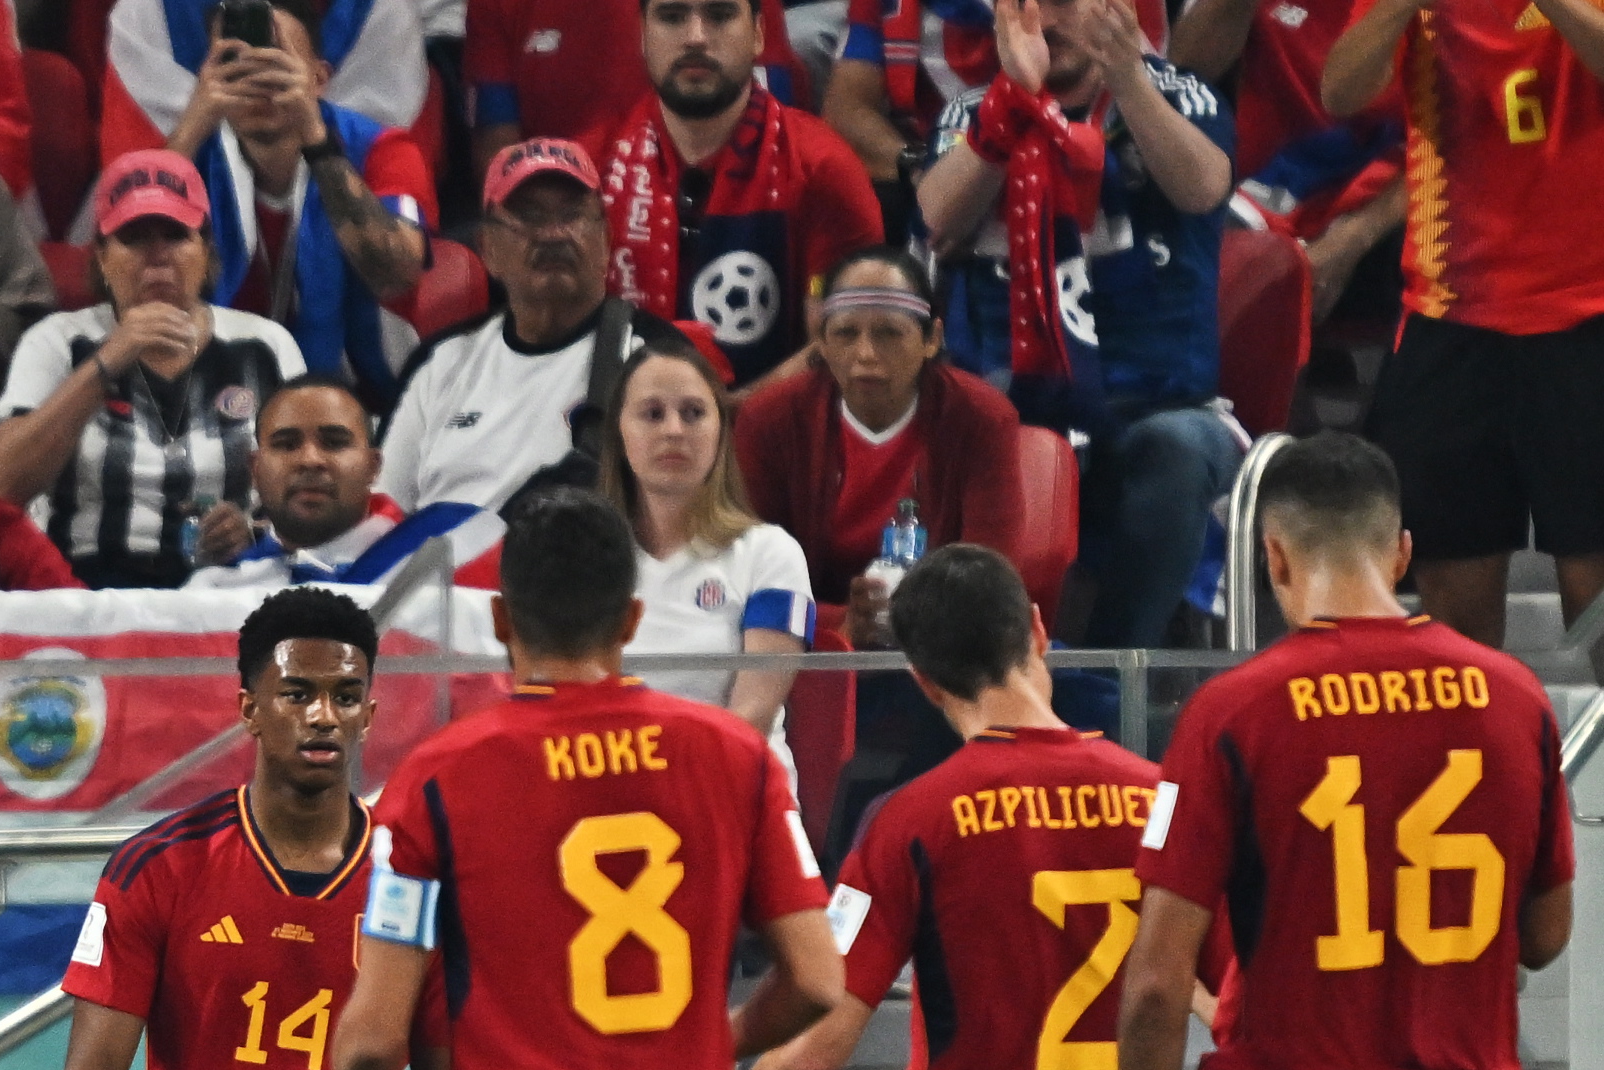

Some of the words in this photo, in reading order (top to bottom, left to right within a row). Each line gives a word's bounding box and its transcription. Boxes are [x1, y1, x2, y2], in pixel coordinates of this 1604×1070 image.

[1504, 69, 1546, 144] 6
[1288, 666, 1490, 721] RODRIGO
[544, 725, 669, 780] KOKE
[951, 784, 1158, 838] AZPILICUET
[1299, 748, 1506, 971] 16
[558, 811, 693, 1035] 8
